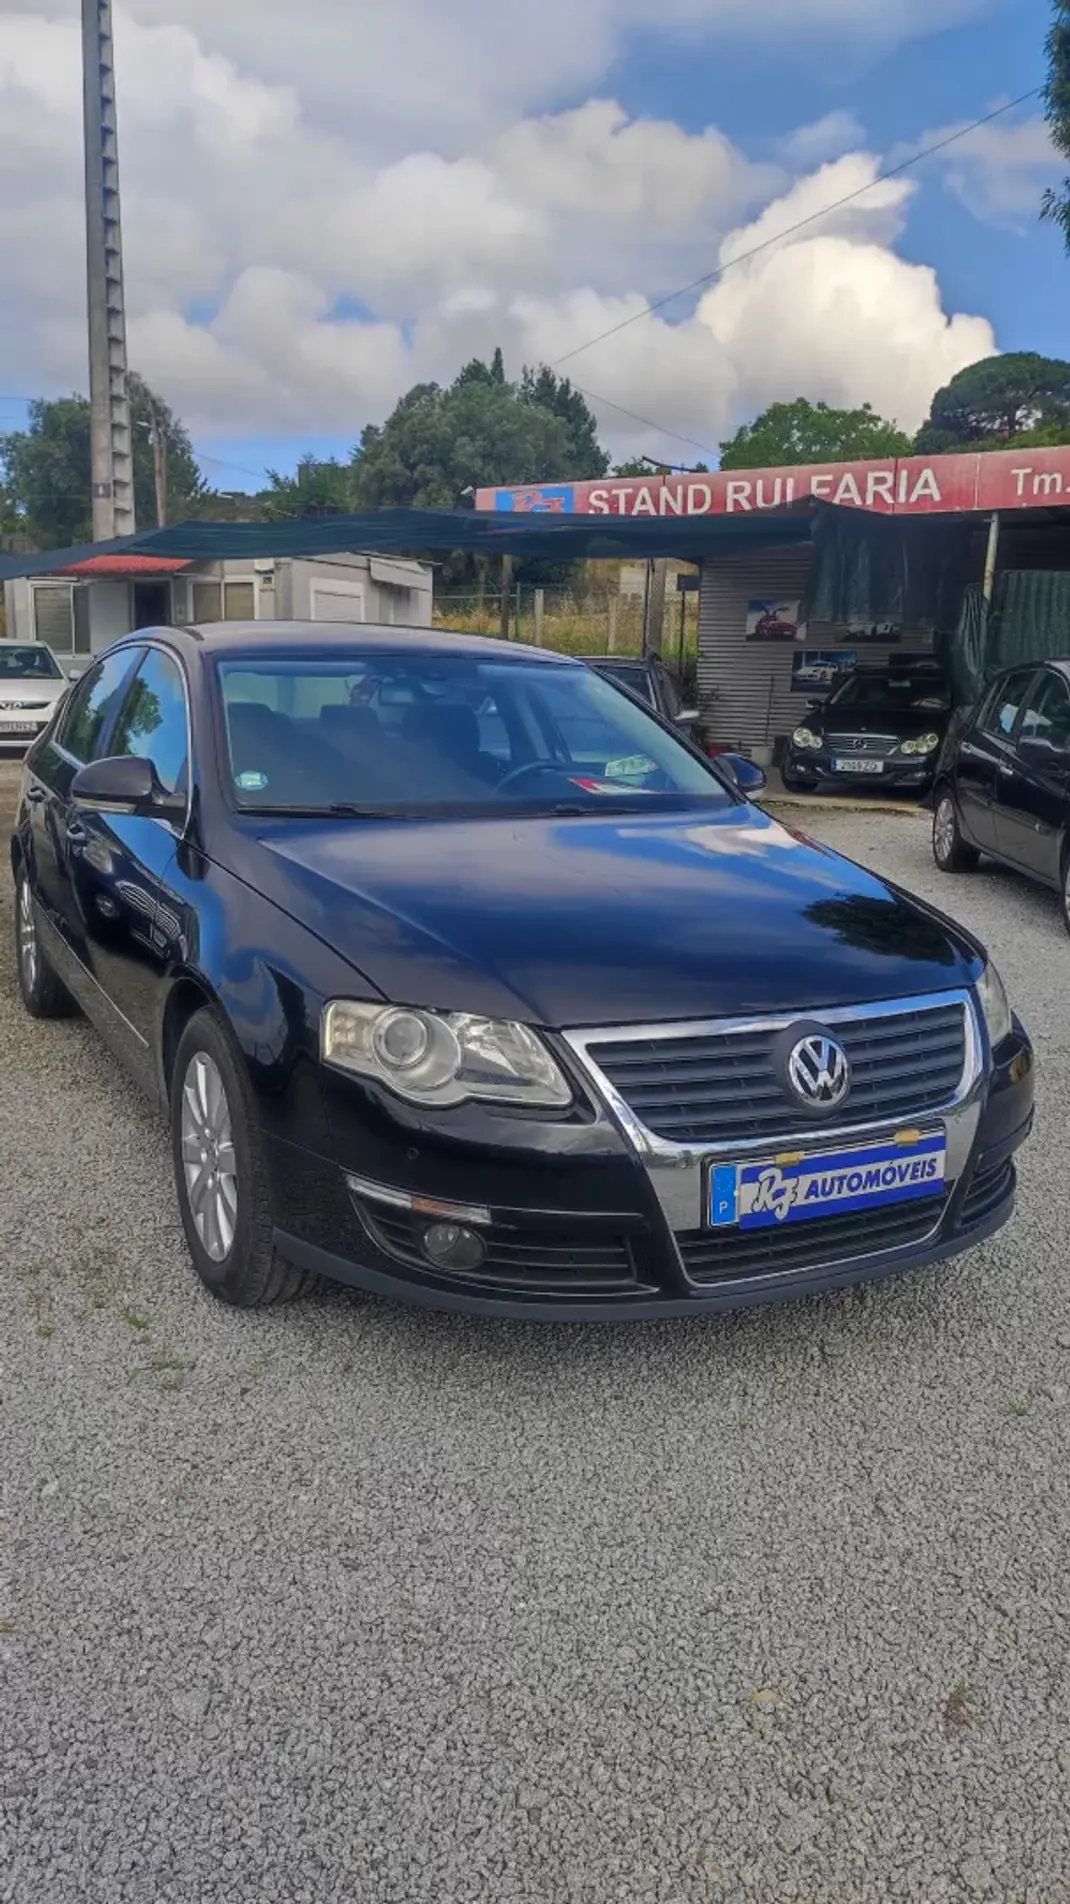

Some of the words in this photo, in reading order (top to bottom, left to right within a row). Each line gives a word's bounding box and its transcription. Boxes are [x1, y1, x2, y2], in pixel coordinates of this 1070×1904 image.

[588, 484, 712, 515] STAND
[726, 477, 794, 512] RUI
[811, 468, 942, 505] FARIA
[1011, 467, 1070, 496] Tm.
[804, 1159, 937, 1200] AUTOMÓVEIS
[719, 1200, 728, 1213] P
